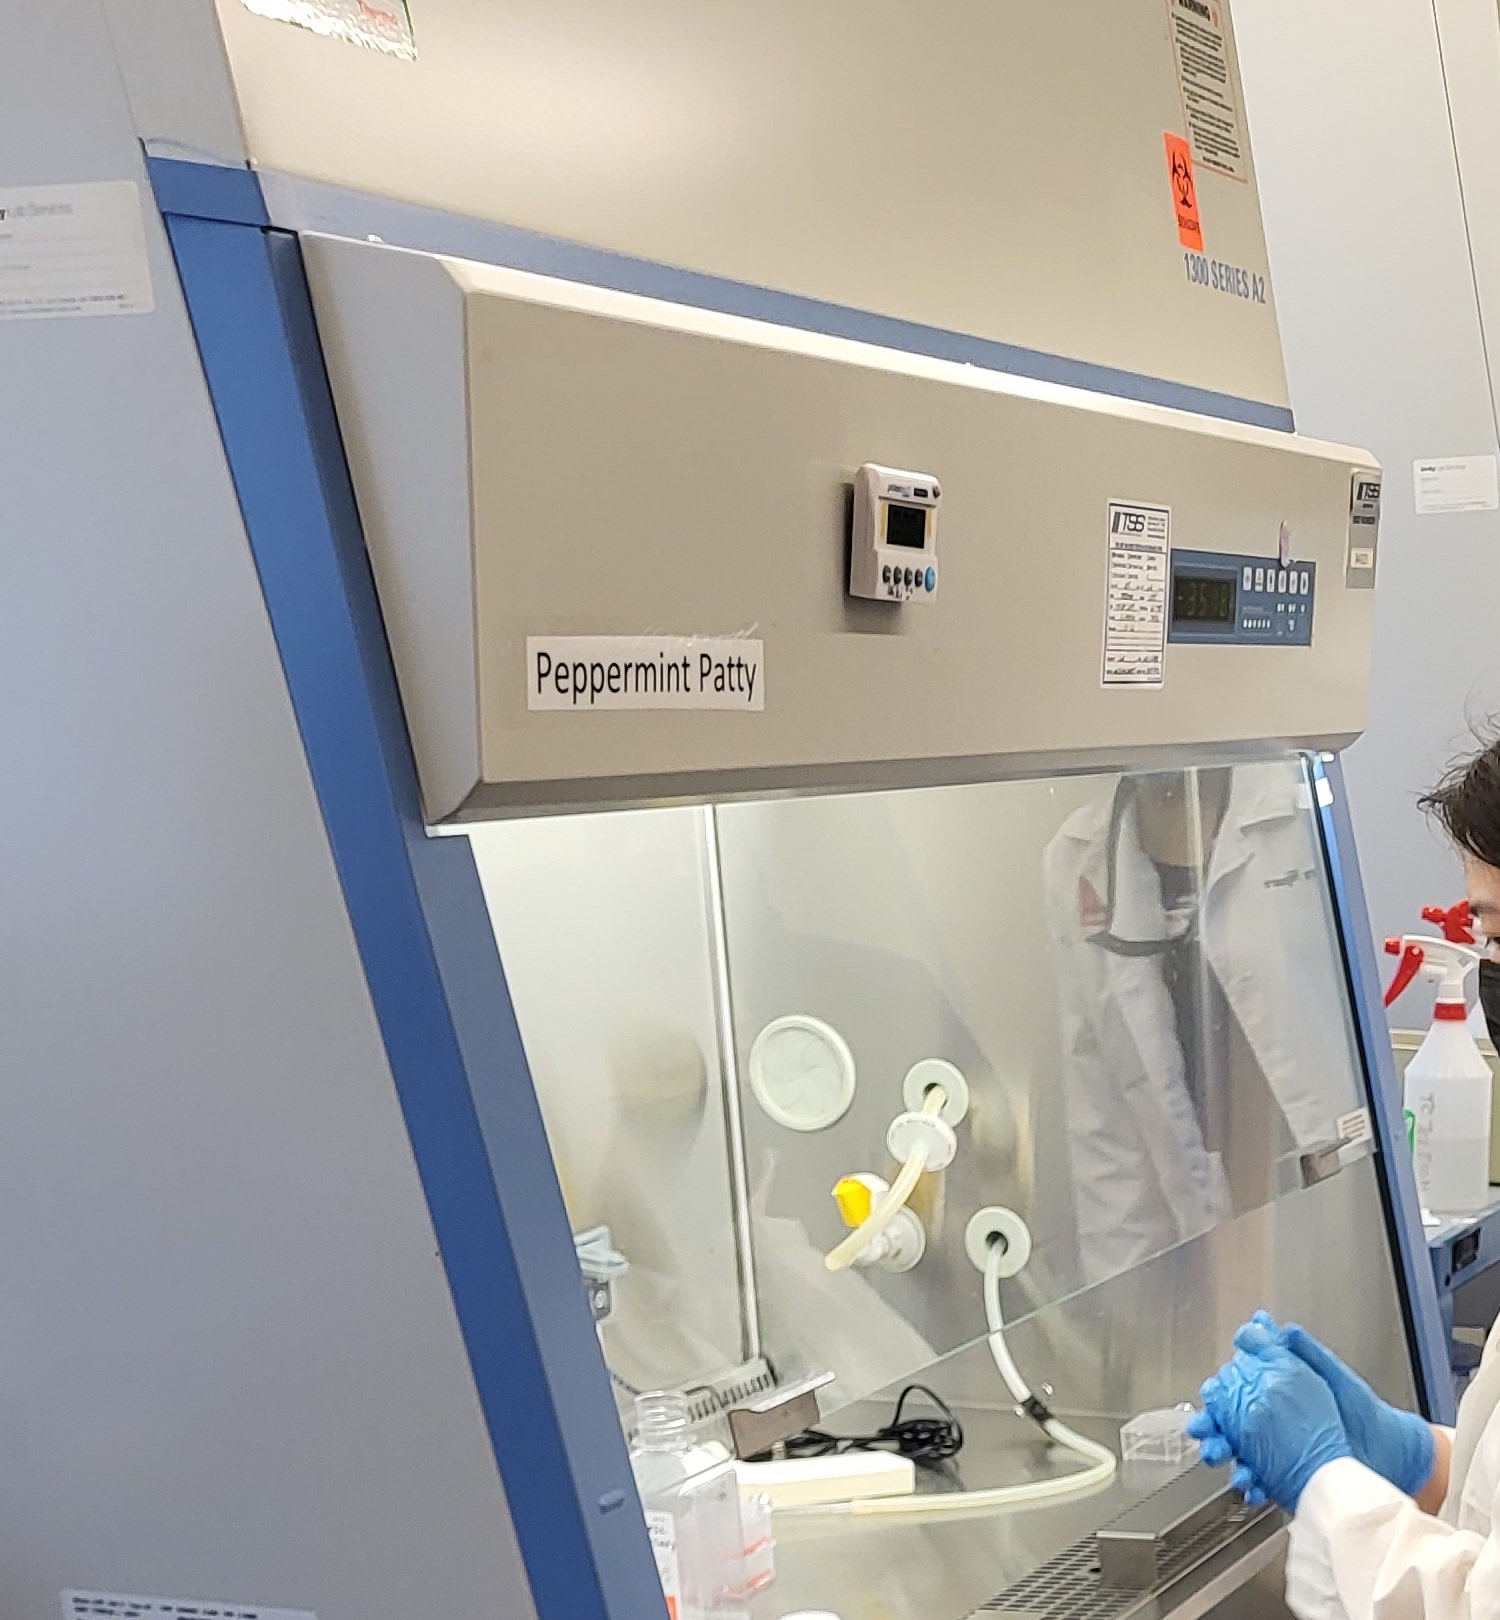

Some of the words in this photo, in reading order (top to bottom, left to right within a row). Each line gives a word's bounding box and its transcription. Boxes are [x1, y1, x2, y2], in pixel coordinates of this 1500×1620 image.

[1184, 252, 1210, 288] 1300
[1210, 259, 1250, 301] SERIES
[1252, 273, 1267, 305] A2
[536, 652, 691, 705] Peppermint
[699, 652, 758, 702] Patty
